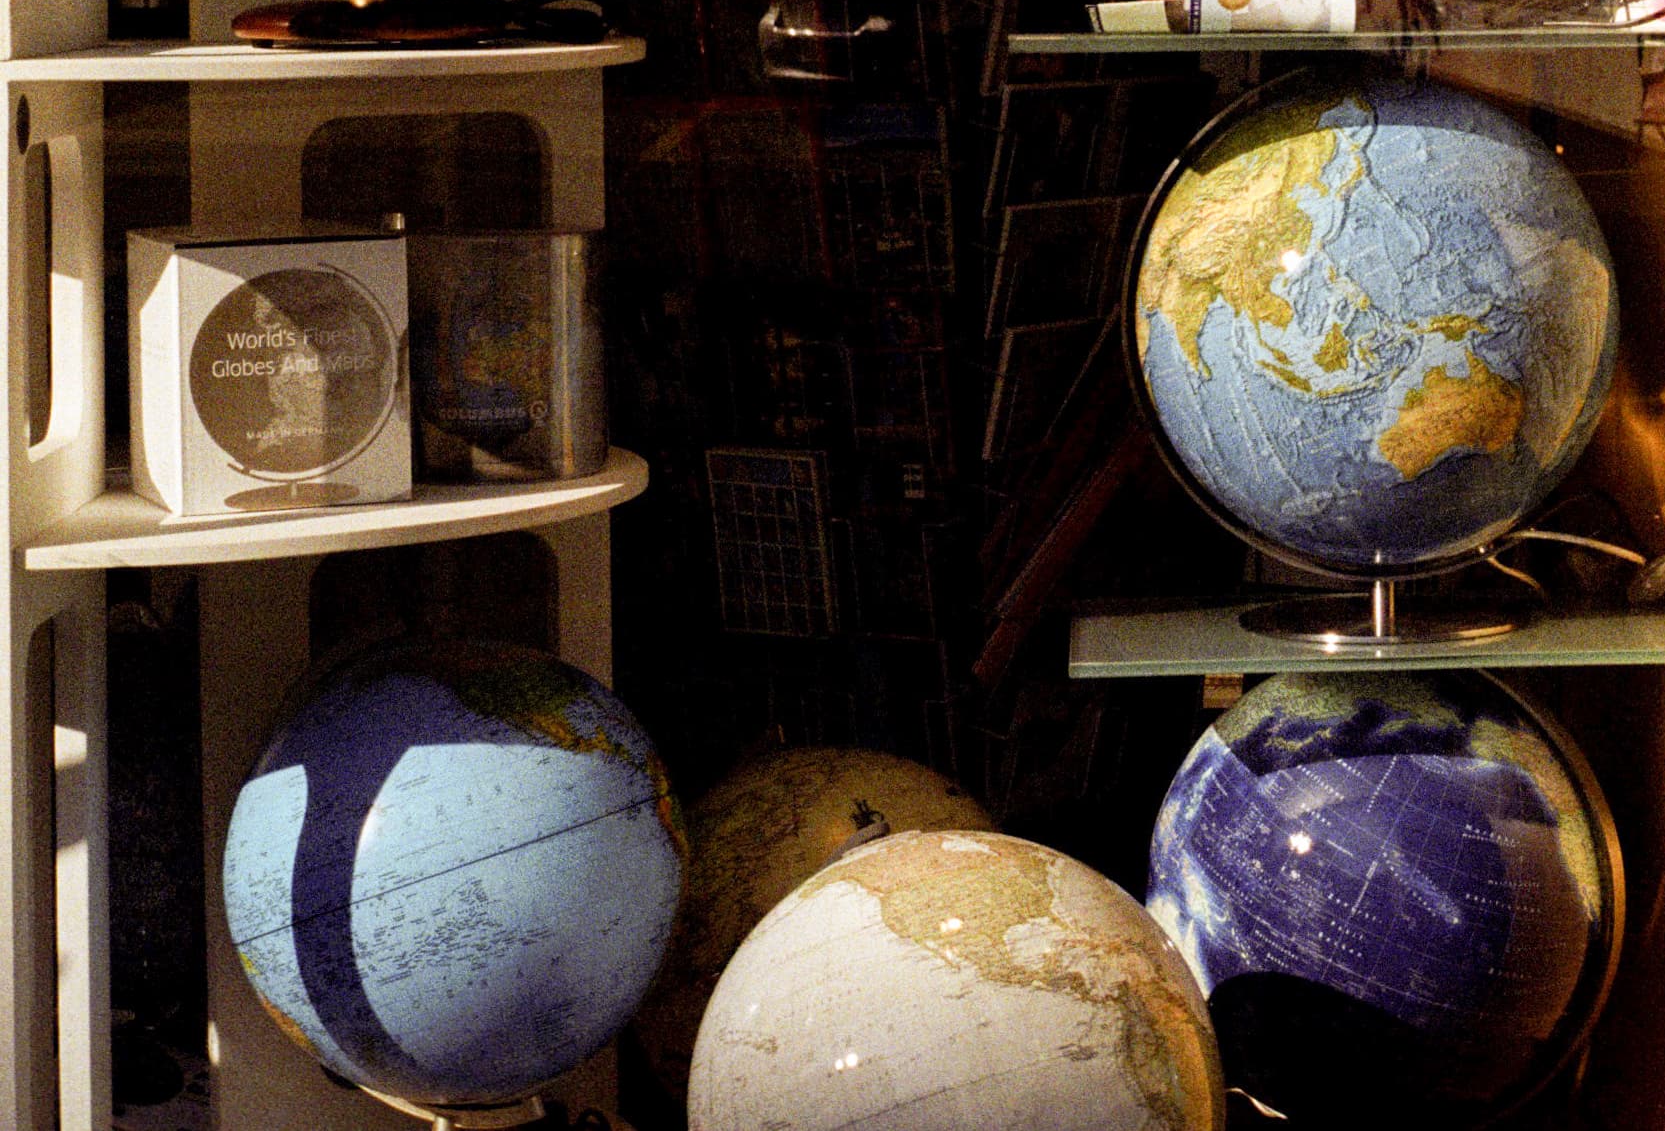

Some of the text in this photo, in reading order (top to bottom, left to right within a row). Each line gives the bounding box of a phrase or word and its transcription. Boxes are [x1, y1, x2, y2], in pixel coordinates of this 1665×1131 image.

[227, 329, 296, 351] World's
[211, 359, 276, 379] Globes
[281, 352, 319, 374] And
